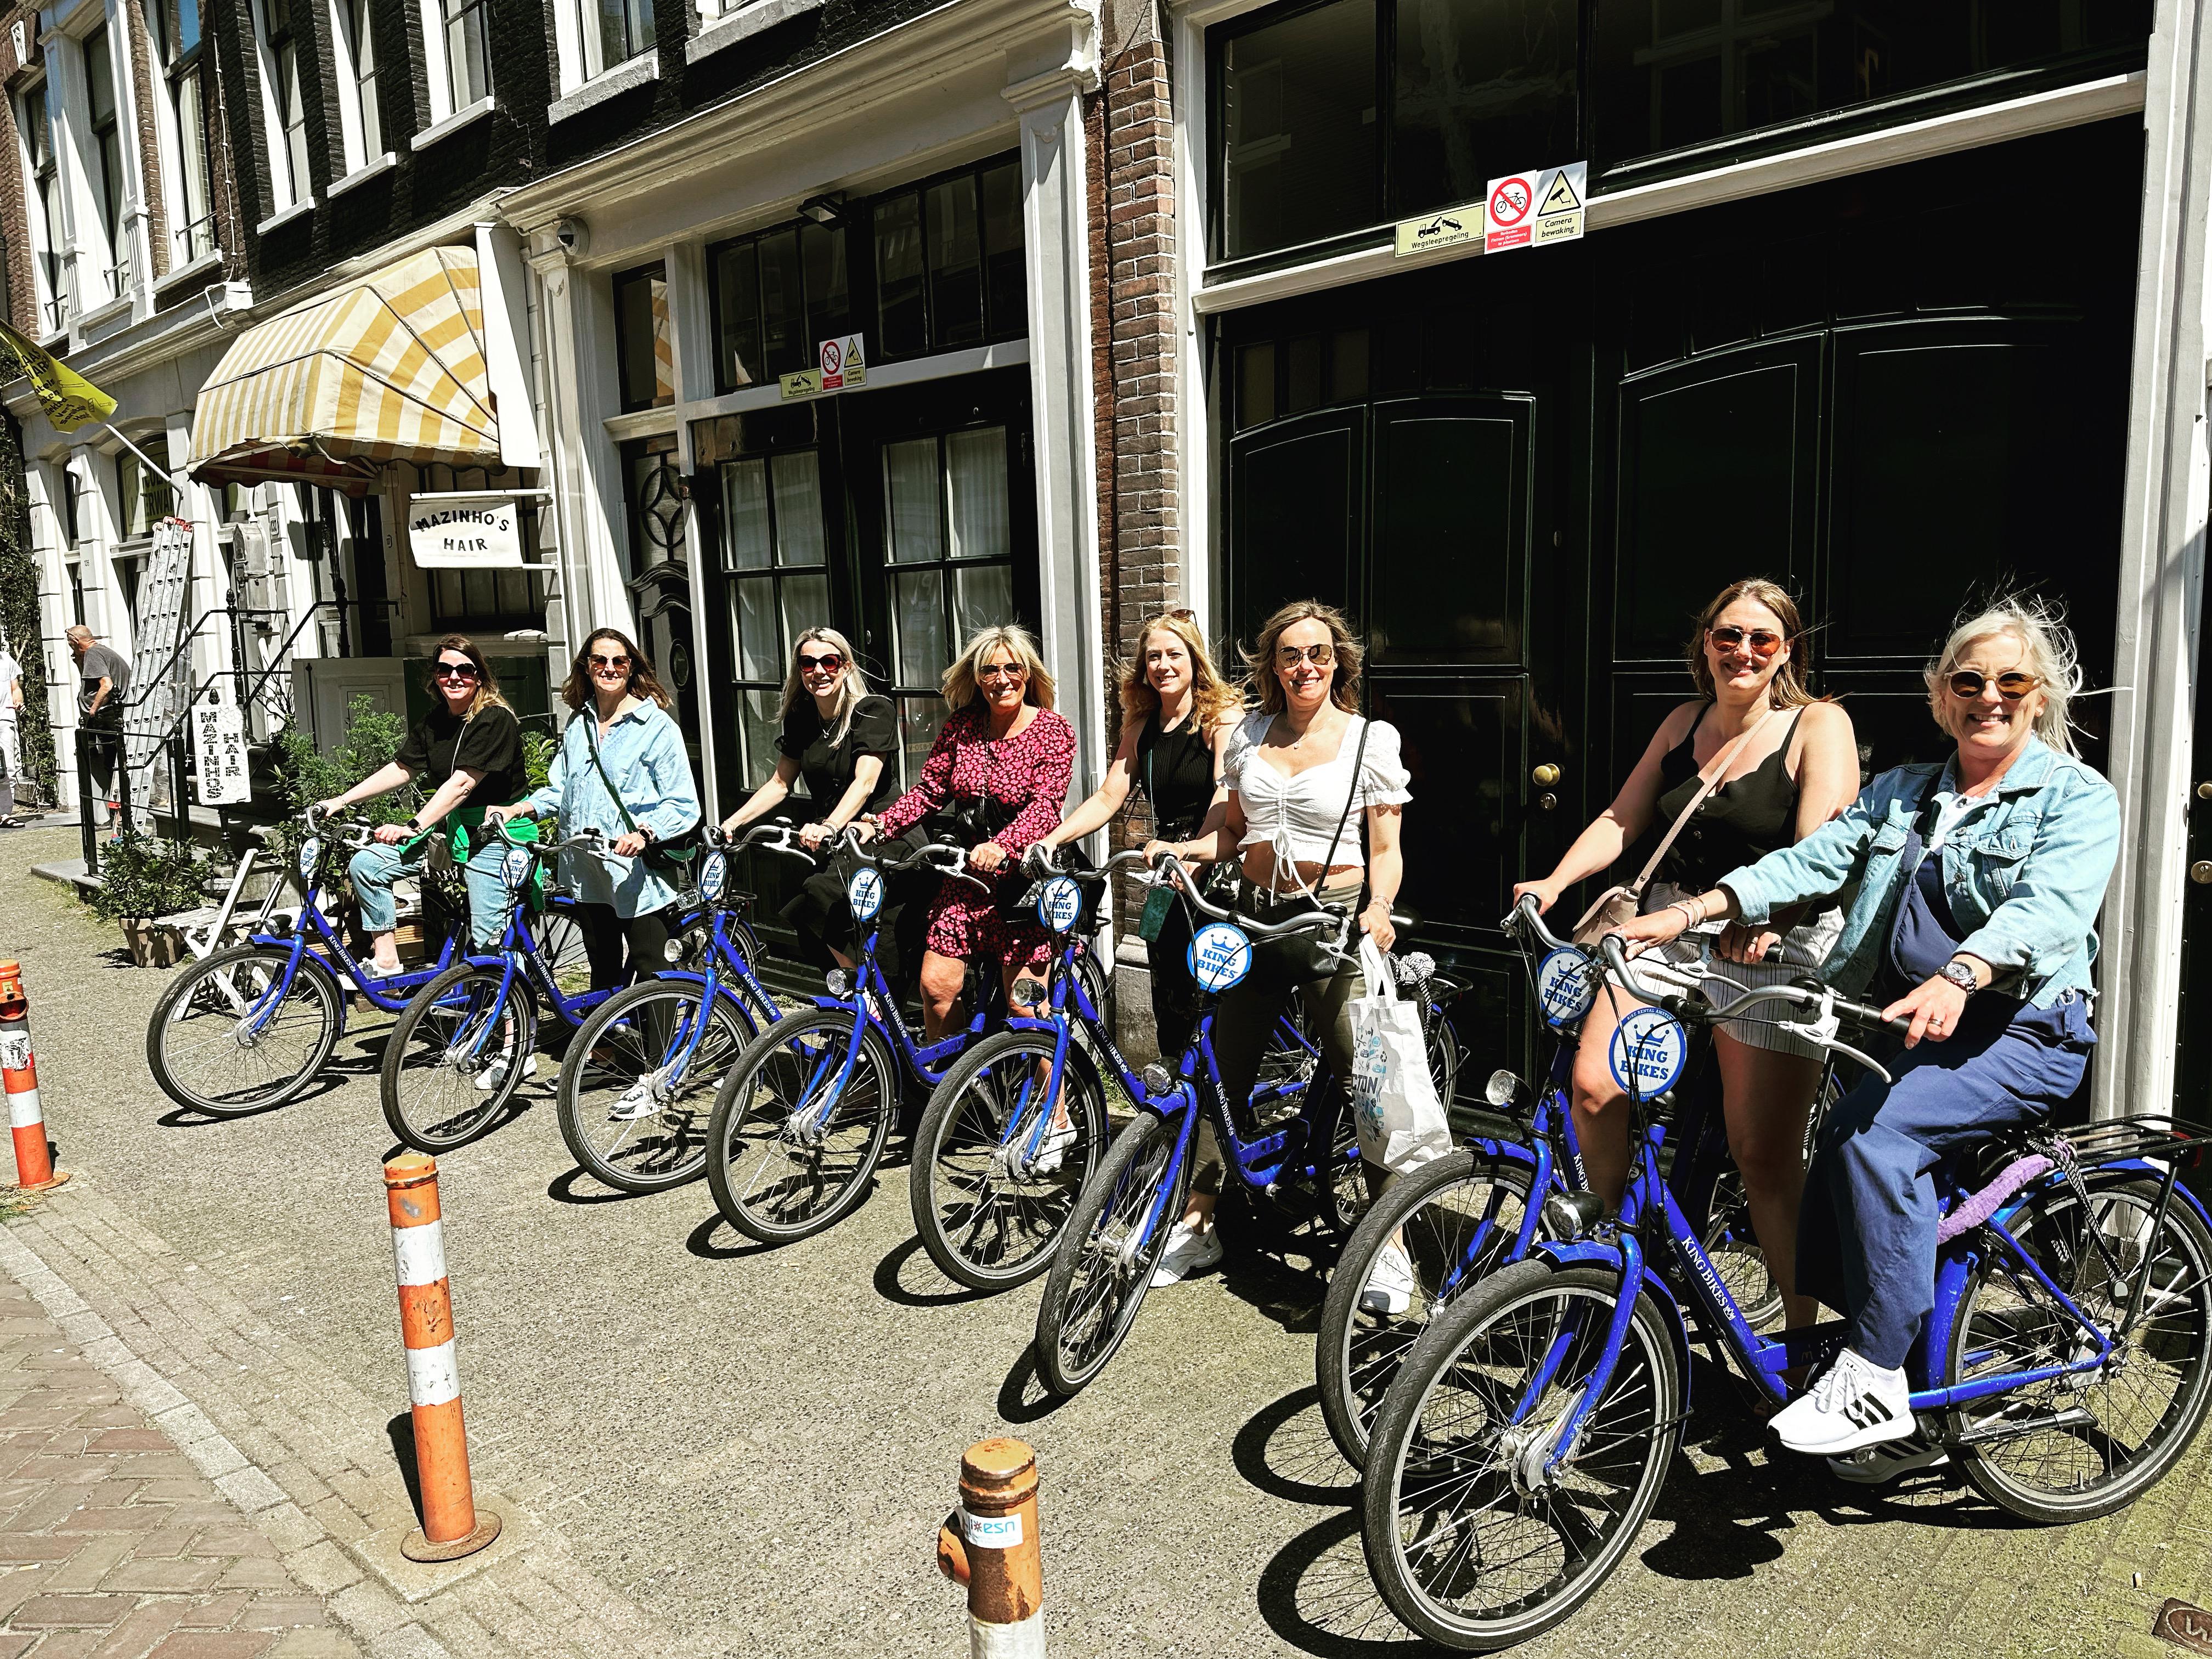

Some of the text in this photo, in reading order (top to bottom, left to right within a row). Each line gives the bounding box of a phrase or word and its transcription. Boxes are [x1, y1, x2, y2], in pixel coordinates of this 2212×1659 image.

[1542, 225, 1575, 238] bewaking
[1545, 217, 1572, 227] Camera
[1412, 231, 1469, 249] Wegsleepregeling
[415, 510, 510, 532] MAZINHO'S
[444, 538, 488, 551] HAIR
[223, 732, 241, 777] HAIR
[328, 935, 352, 967] KING BIKES
[1202, 949, 1237, 966] KING
[532, 951, 552, 983] KING BIKES
[743, 972, 771, 1009] KING BIKES
[1549, 977, 1583, 997] KING
[1544, 988, 1582, 1012] BIKES
[884, 992, 905, 1031] KING BIKES
[1627, 1012, 1637, 1020] BIKE
[1094, 1021, 1124, 1065] KING BIKES
[1627, 1045, 1668, 1063] KING
[1620, 1060, 1669, 1080] BIKES
[1216, 1081, 1233, 1127] KING BIKES
[1573, 1153, 1586, 1181] KING
[1681, 1235, 1728, 1307] KING BIKES
[984, 1521, 1015, 1533] esn
